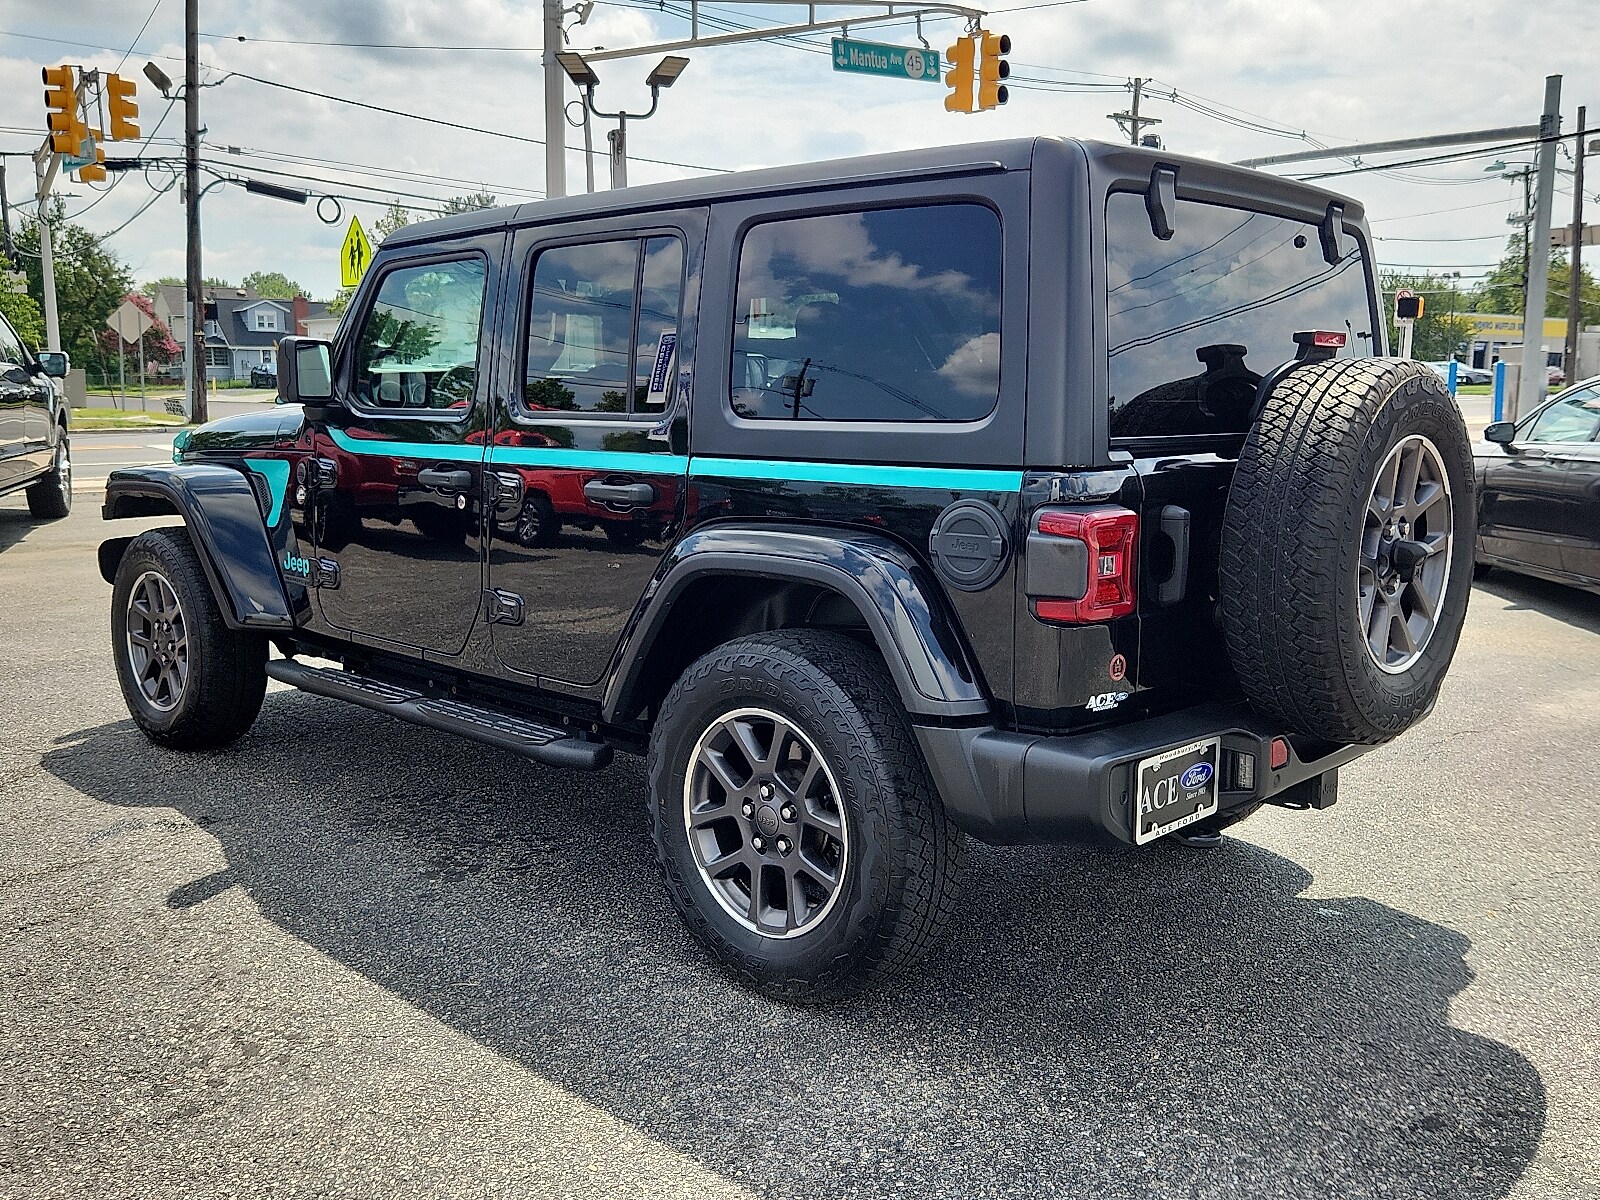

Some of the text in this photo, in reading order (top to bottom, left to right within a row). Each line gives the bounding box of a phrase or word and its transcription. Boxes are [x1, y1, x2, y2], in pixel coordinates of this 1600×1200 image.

[837, 43, 844, 55] N
[849, 48, 902, 69] Mantua Ave
[906, 55, 922, 71] 45
[929, 55, 935, 66] S
[1399, 399, 1473, 494] BRIDGESTONE
[951, 538, 979, 553] Jeep
[283, 551, 310, 577] Jeep
[1085, 692, 1117, 709] ACE
[720, 676, 863, 821] BRIDGESTONE
[1141, 767, 1207, 815] ACE Ford
[758, 814, 775, 828] Jeep
[1155, 813, 1200, 836] ACE FORD
